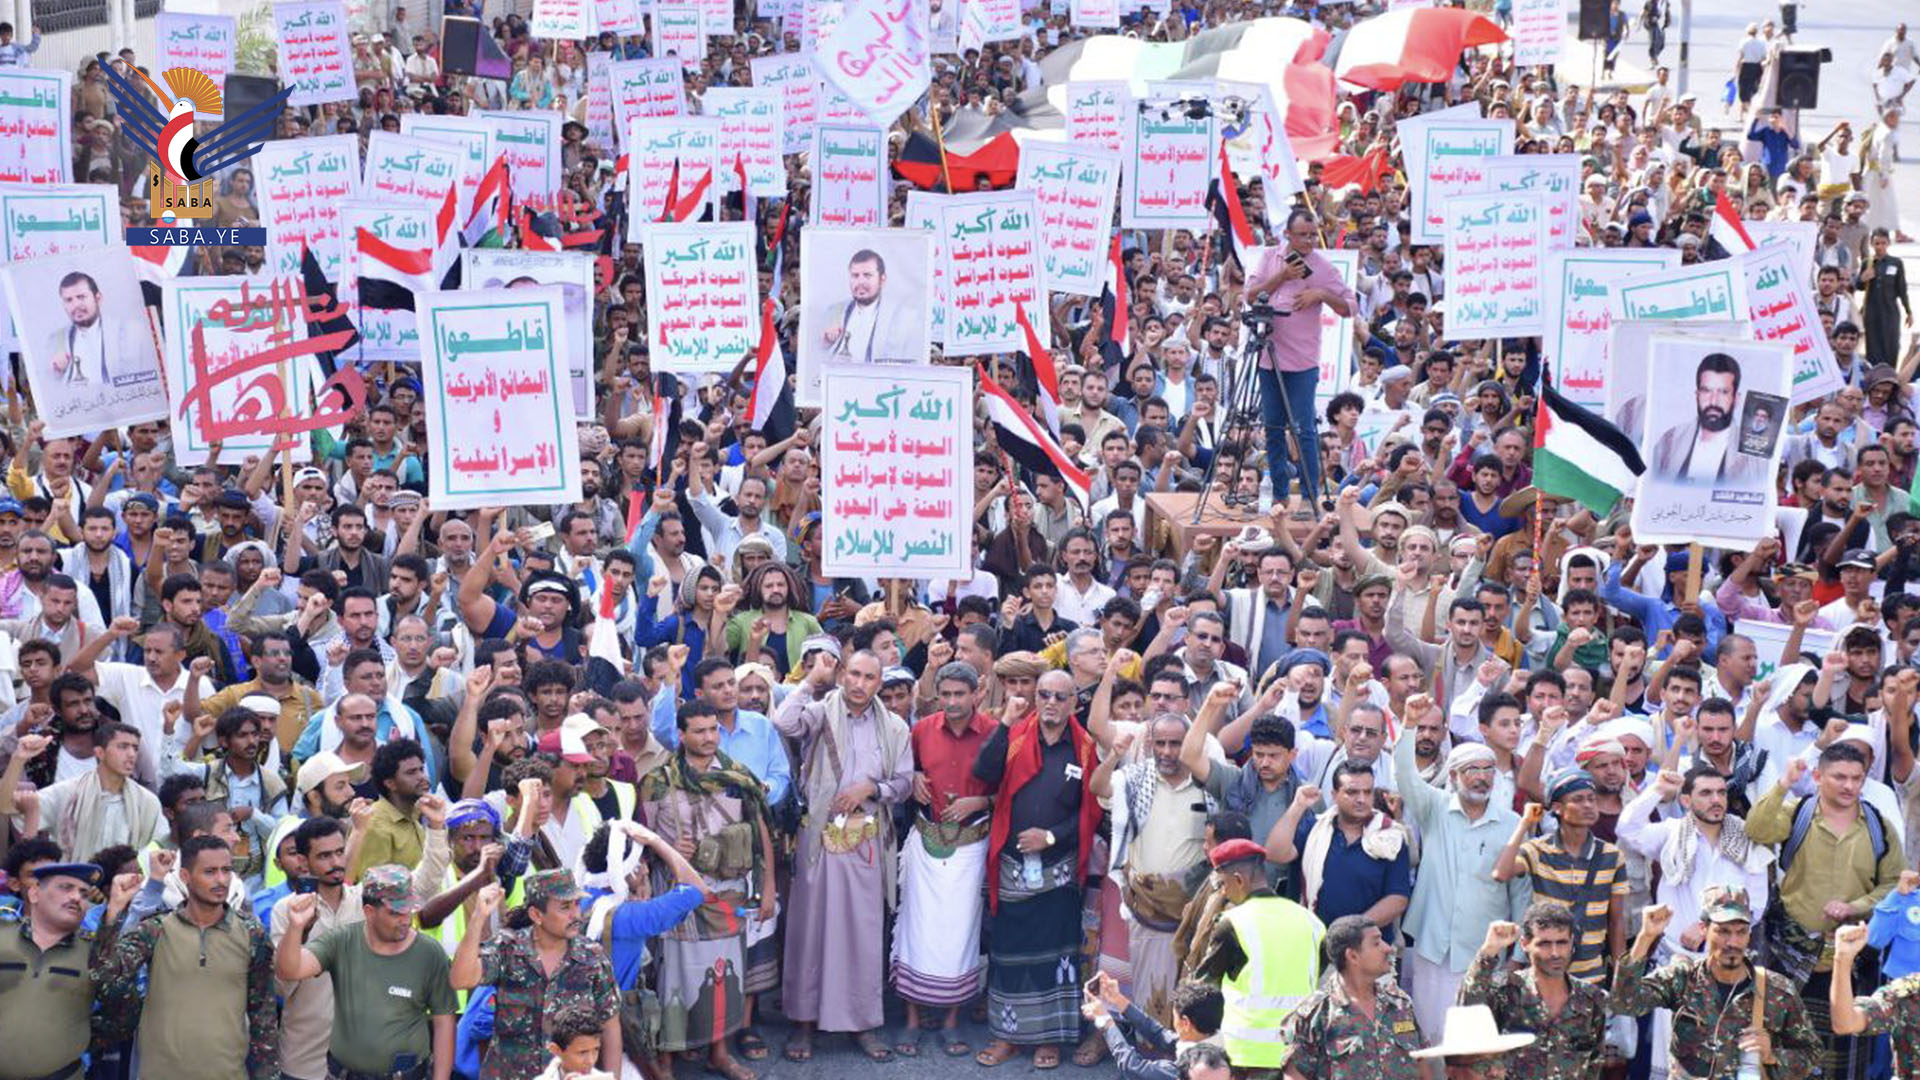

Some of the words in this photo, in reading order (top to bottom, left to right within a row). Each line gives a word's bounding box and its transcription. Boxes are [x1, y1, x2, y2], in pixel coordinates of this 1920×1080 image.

[623, 67, 652, 92] أكبر
[655, 69, 674, 83] الله
[751, 100, 773, 115] الله
[645, 129, 686, 154] أكبر
[688, 131, 713, 149] الله
[823, 138, 876, 159] قاطعوا
[1431, 137, 1497, 160] قاطعوا
[267, 152, 313, 182] أكبر
[317, 152, 346, 173] الله
[379, 150, 426, 172] أكبر
[425, 157, 453, 178] الله
[1030, 157, 1078, 183] أكبر
[1078, 163, 1107, 184] الله
[316, 181, 350, 198] الموت
[1070, 195, 1102, 209] الموت
[11, 206, 100, 238] قاطعوا
[951, 207, 997, 241] أكبر
[1000, 208, 1030, 231] الله
[1067, 216, 1098, 231] الموت
[1456, 203, 1505, 232] أكبر
[1507, 203, 1537, 224] الله
[396, 217, 426, 239] الله
[713, 240, 744, 261] الله
[952, 239, 994, 262] لأمريكا
[997, 241, 1032, 259] الموت
[1456, 233, 1499, 253] لأمريكا
[1501, 233, 1536, 249] الموت
[660, 238, 709, 268] أكبر
[1501, 255, 1537, 272] الموت
[955, 266, 995, 287] لإسرائيل
[999, 264, 1034, 284] الموت
[1456, 256, 1499, 277] لإسرائيل
[1756, 264, 1789, 290] الله
[661, 268, 706, 289] لأمريكا
[709, 270, 745, 288] الموت
[1456, 278, 1487, 296] اليهود
[1489, 281, 1506, 296] على
[1510, 276, 1537, 291] اللعنة
[664, 292, 707, 311] لإسرائيل
[711, 293, 746, 309] الموت
[955, 291, 985, 310] اليهود
[989, 293, 1005, 308] على
[1009, 287, 1036, 302] اللعنة
[1758, 291, 1798, 318] الموت
[700, 314, 716, 331] على
[721, 314, 748, 328] اللعنة
[1455, 299, 1498, 326] للإسلام
[1502, 299, 1539, 324] النصر
[956, 314, 997, 341] للإسلام
[1767, 314, 1806, 340] الموت
[441, 317, 545, 363] قاطعوا
[714, 336, 751, 359] النصر
[445, 366, 498, 404] الأمريكية
[499, 368, 549, 402] البضائع
[835, 384, 906, 427] أكبر
[910, 390, 953, 421] الله
[493, 408, 502, 434] و
[835, 429, 897, 457] لأمريكا
[901, 436, 952, 459] الموت
[452, 442, 556, 479] الإسرائيلية
[834, 462, 897, 492] لإسرائيل
[901, 467, 952, 491] الموت
[834, 496, 879, 520] اليهود
[883, 498, 907, 522] على
[913, 497, 952, 519] اللعنة
[834, 528, 895, 564] للإسلام
[901, 528, 953, 562] النصر
